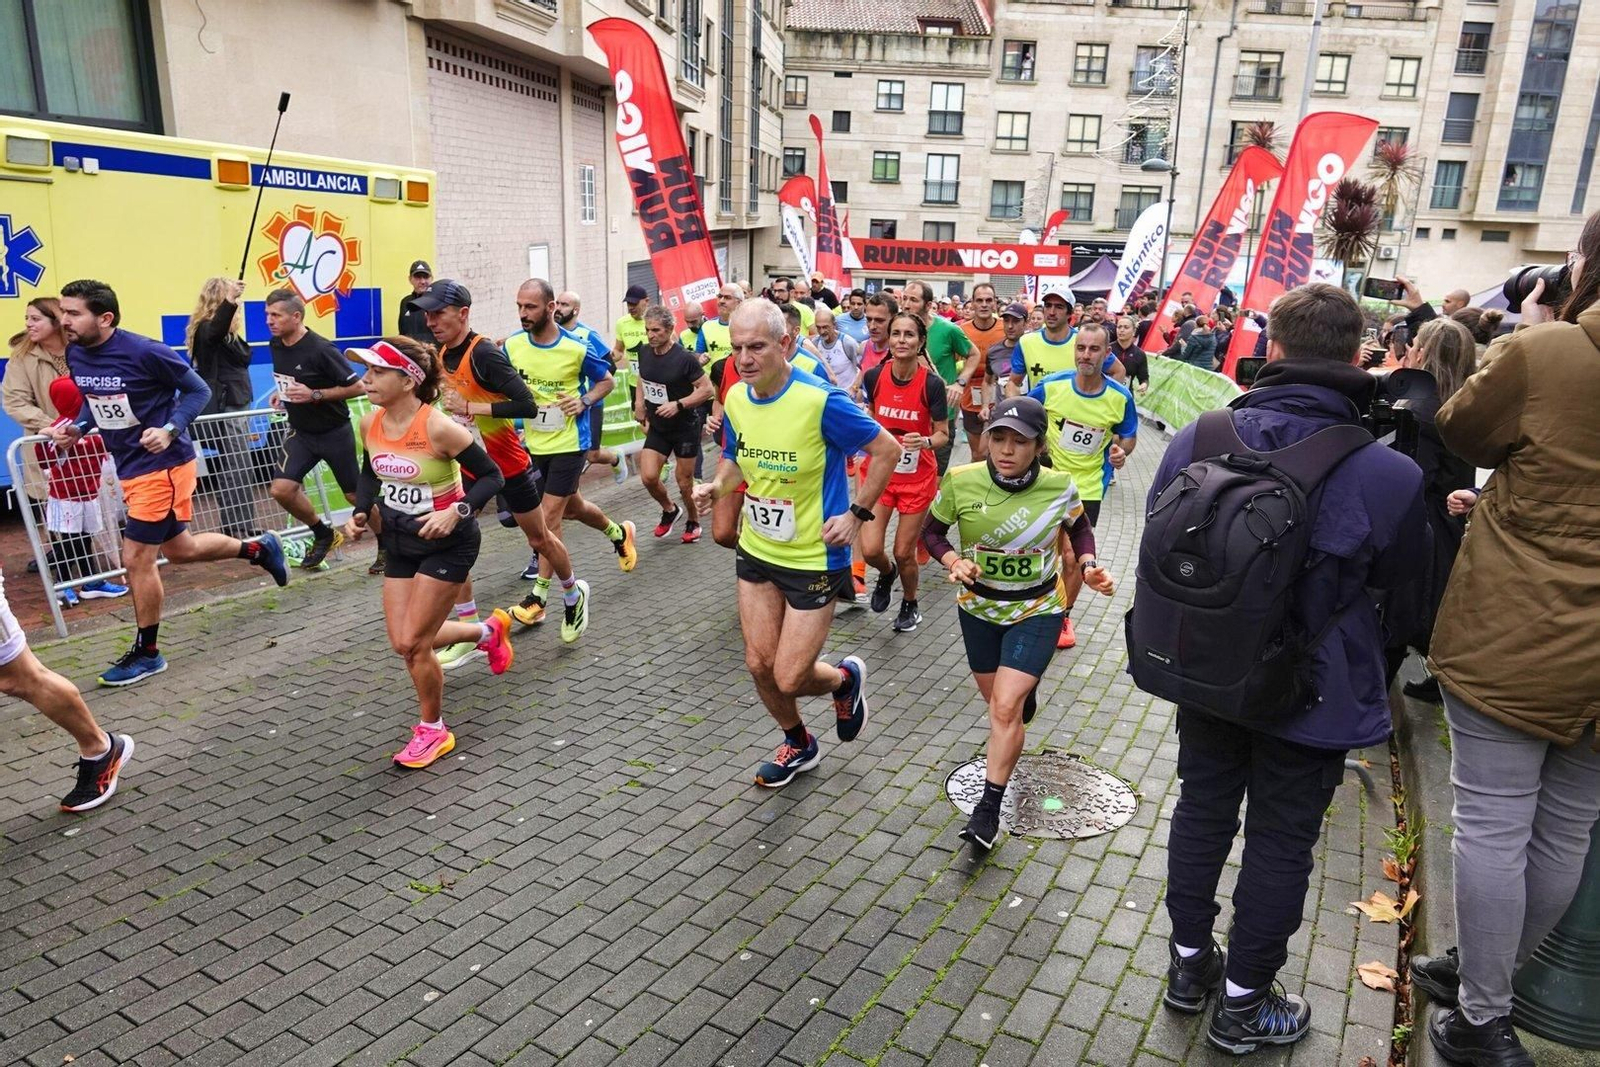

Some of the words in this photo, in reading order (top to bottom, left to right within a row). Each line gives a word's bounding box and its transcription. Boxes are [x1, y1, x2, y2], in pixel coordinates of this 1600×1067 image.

[260, 168, 361, 192] AMBULANCIA
[1184, 219, 1225, 281] RUN
[1117, 224, 1164, 298] Atlántico
[645, 385, 664, 397] 136
[95, 404, 125, 419] 158
[1072, 431, 1093, 445] 68
[742, 447, 798, 462] DEPORTE
[375, 460, 415, 475] Serrano
[388, 484, 422, 504] 260
[750, 504, 784, 527] 137
[993, 506, 1031, 538] auga
[985, 556, 1033, 577] 568
